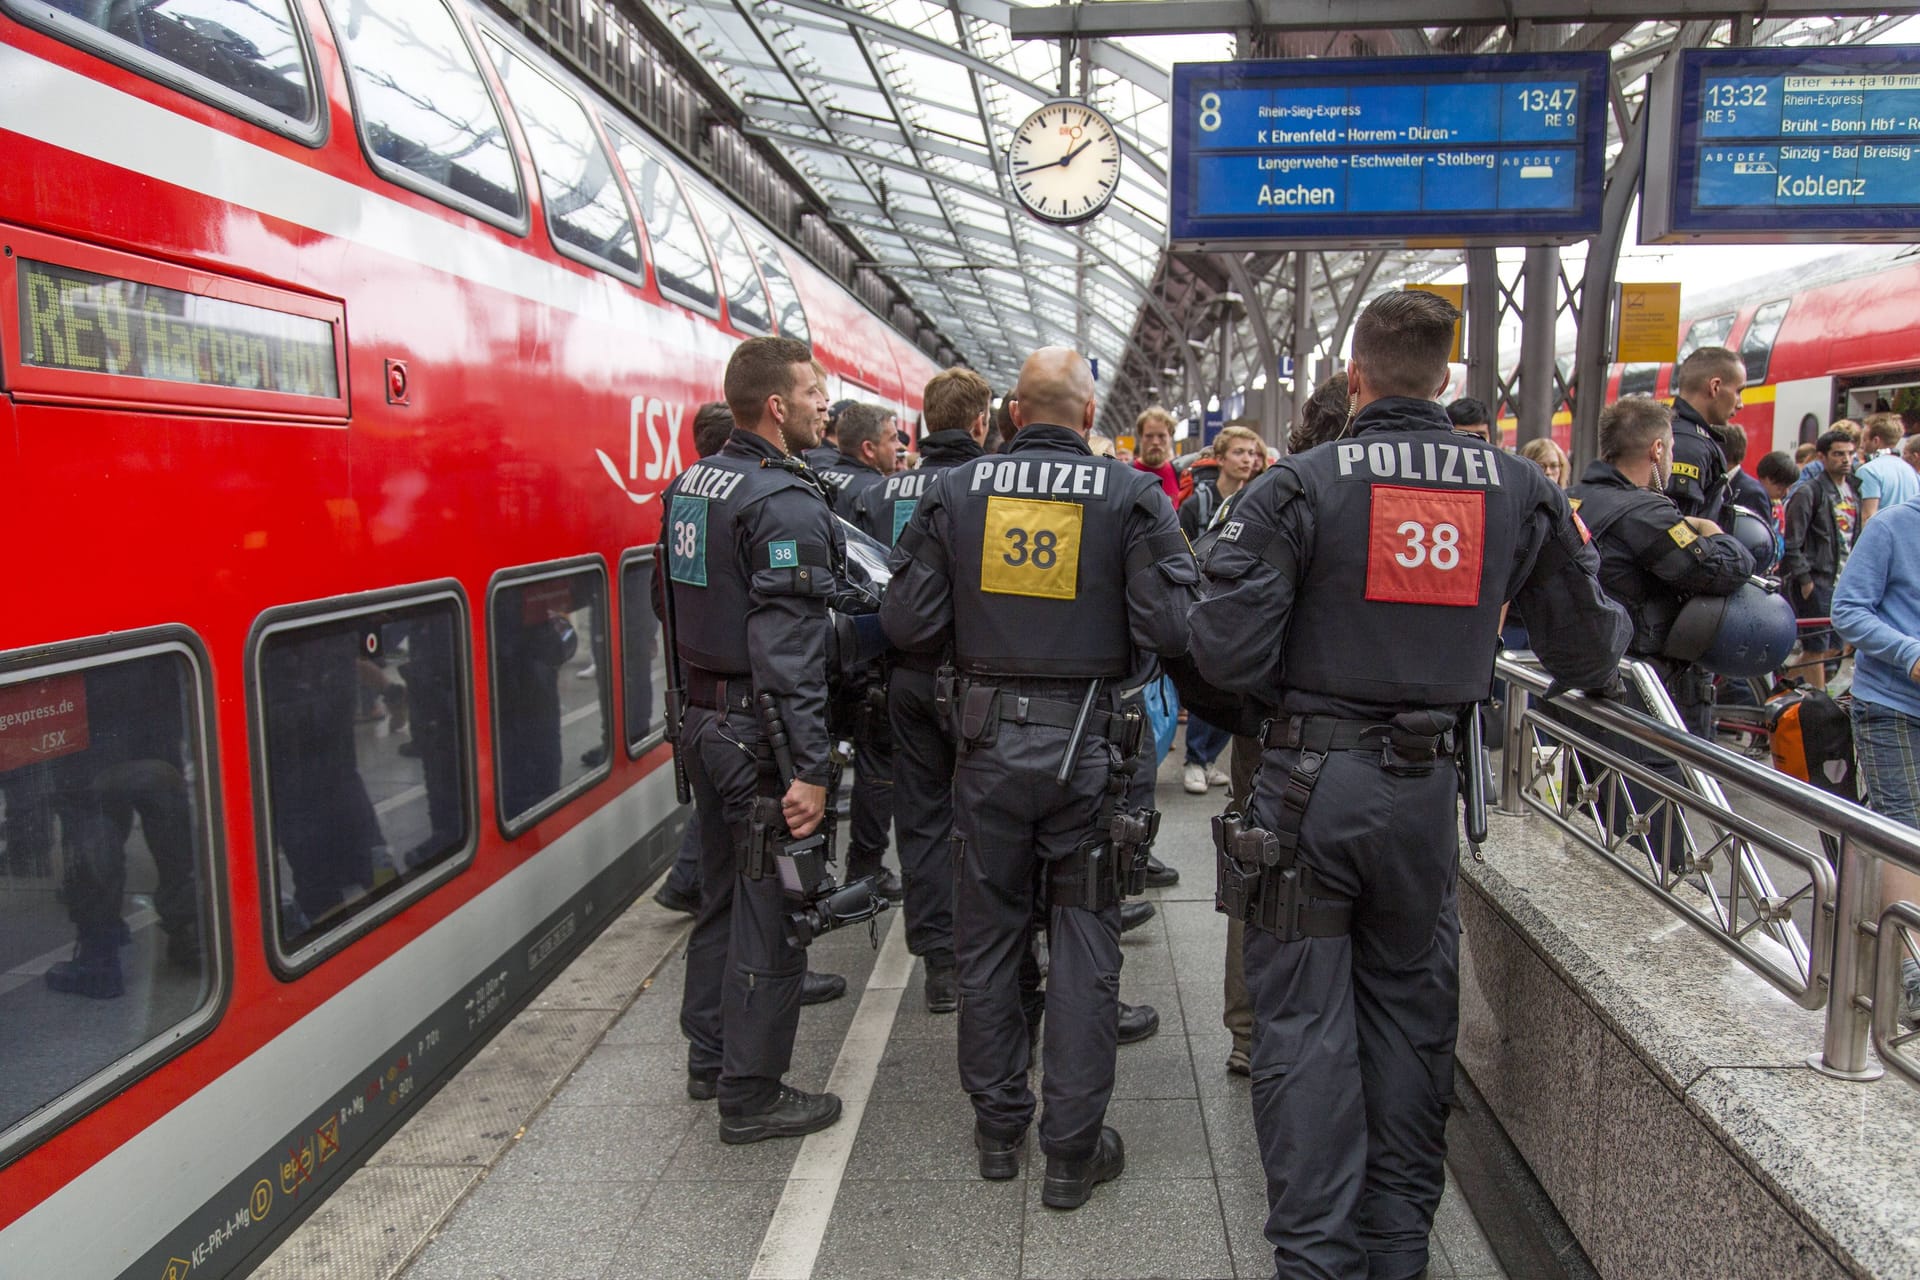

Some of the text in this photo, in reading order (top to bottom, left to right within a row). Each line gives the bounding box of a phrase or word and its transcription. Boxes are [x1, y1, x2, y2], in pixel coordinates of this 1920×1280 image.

[1518, 89, 1577, 112] 13:47
[1707, 84, 1768, 107] 13:32
[1783, 94, 1864, 107] Rhein-Express
[1199, 92, 1222, 132] 8
[1258, 103, 1361, 118] Rhein-Sieg-Express
[1545, 113, 1576, 127] RE 9
[1705, 109, 1736, 123] RE 5
[1258, 130, 1268, 144] K
[1271, 128, 1336, 144] Ehrenfeld
[1348, 127, 1397, 142] Horrem
[1408, 126, 1449, 141] Düren
[1781, 118, 1819, 133] Brühl
[1831, 118, 1866, 132] Bonn
[1870, 117, 1896, 131] Hbf
[1258, 155, 1339, 171] Langerwehe
[1351, 153, 1424, 169] Eschweiler
[1437, 152, 1495, 169] Stolberg
[1780, 146, 1821, 162] Sinzig
[1832, 145, 1859, 159] Bad
[1863, 144, 1911, 161] Breisig
[1257, 183, 1336, 206] Aachen
[1777, 175, 1866, 197] Koblenz
[1337, 442, 1501, 487] POLIZEI
[677, 464, 745, 500] POLIZEI
[884, 473, 938, 500] POL
[971, 461, 1109, 496] POLIZEI
[674, 520, 697, 560] 38
[1002, 527, 1058, 570] 38
[1394, 520, 1461, 570] 38
[774, 547, 793, 561] 38
[191, 1207, 251, 1269] KE-PR-A-Mg
